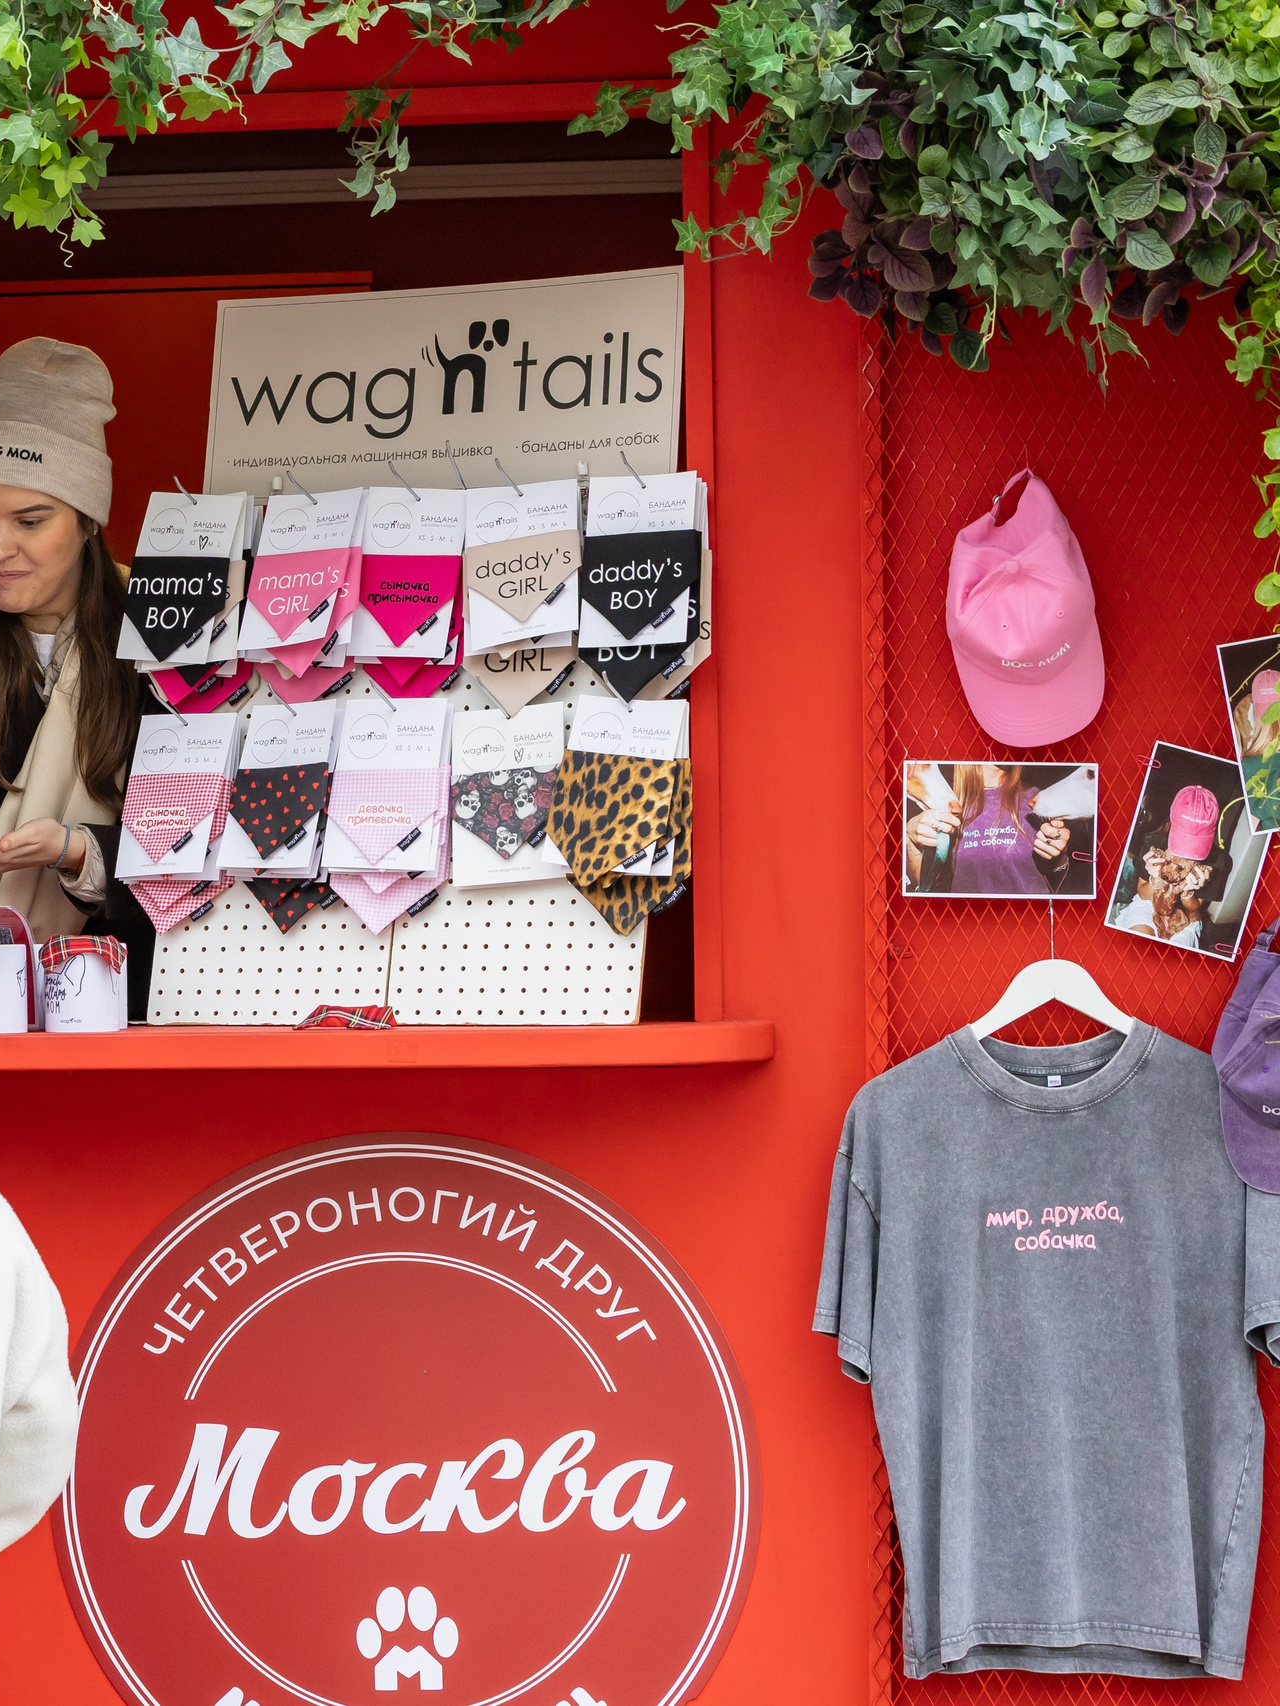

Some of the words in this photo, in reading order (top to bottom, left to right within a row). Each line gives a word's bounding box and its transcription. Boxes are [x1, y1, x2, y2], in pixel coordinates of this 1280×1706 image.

[521, 437, 585, 454] банданы
[588, 436, 613, 450] для
[615, 430, 660, 447] собак
[6, 446, 43, 464] MOM
[233, 452, 349, 468] индивидуальная
[351, 448, 428, 464] машинная
[527, 504, 569, 515] БАНДАНА
[648, 499, 687, 508] БАНДАНА
[316, 513, 350, 523] БАНДАНА
[420, 515, 459, 524] БАНДАНА
[193, 521, 227, 530] БАНДАНА
[475, 548, 572, 579] daddy's
[589, 557, 682, 583] daddy's
[127, 572, 224, 595] mama's
[258, 565, 340, 591] mama's
[380, 581, 430, 592] сыночка
[498, 575, 548, 598] GIRL
[267, 594, 310, 616] GIRL
[367, 593, 439, 605] присыночка
[610, 588, 658, 610] BOY
[145, 606, 195, 629] BOY
[484, 647, 553, 673] GIRL
[1001, 659, 1035, 669] DOG
[1038, 642, 1071, 667] MOM
[296, 728, 327, 736] БАНДАНА
[396, 725, 435, 733] БАНДАНА
[632, 727, 670, 737] БАНДАНА
[187, 738, 222, 746] БАНДАНА
[513, 731, 553, 742] БАНДАНА
[145, 809, 185, 818] сыночка
[358, 804, 403, 815] девочка
[136, 818, 189, 829] корзиночка
[347, 814, 412, 826] припевочка
[983, 825, 1018, 837] дружба,
[1262, 1104, 1280, 1116] DO
[985, 1208, 1033, 1230] мир,
[1040, 1200, 1125, 1228] дружба,
[1014, 1228, 1097, 1252] собачка
[142, 1186, 539, 1356] ЧЕТВЕРОНОГИЙ
[537, 1238, 657, 1343] ДРУГ
[123, 1423, 686, 1539] Москва
